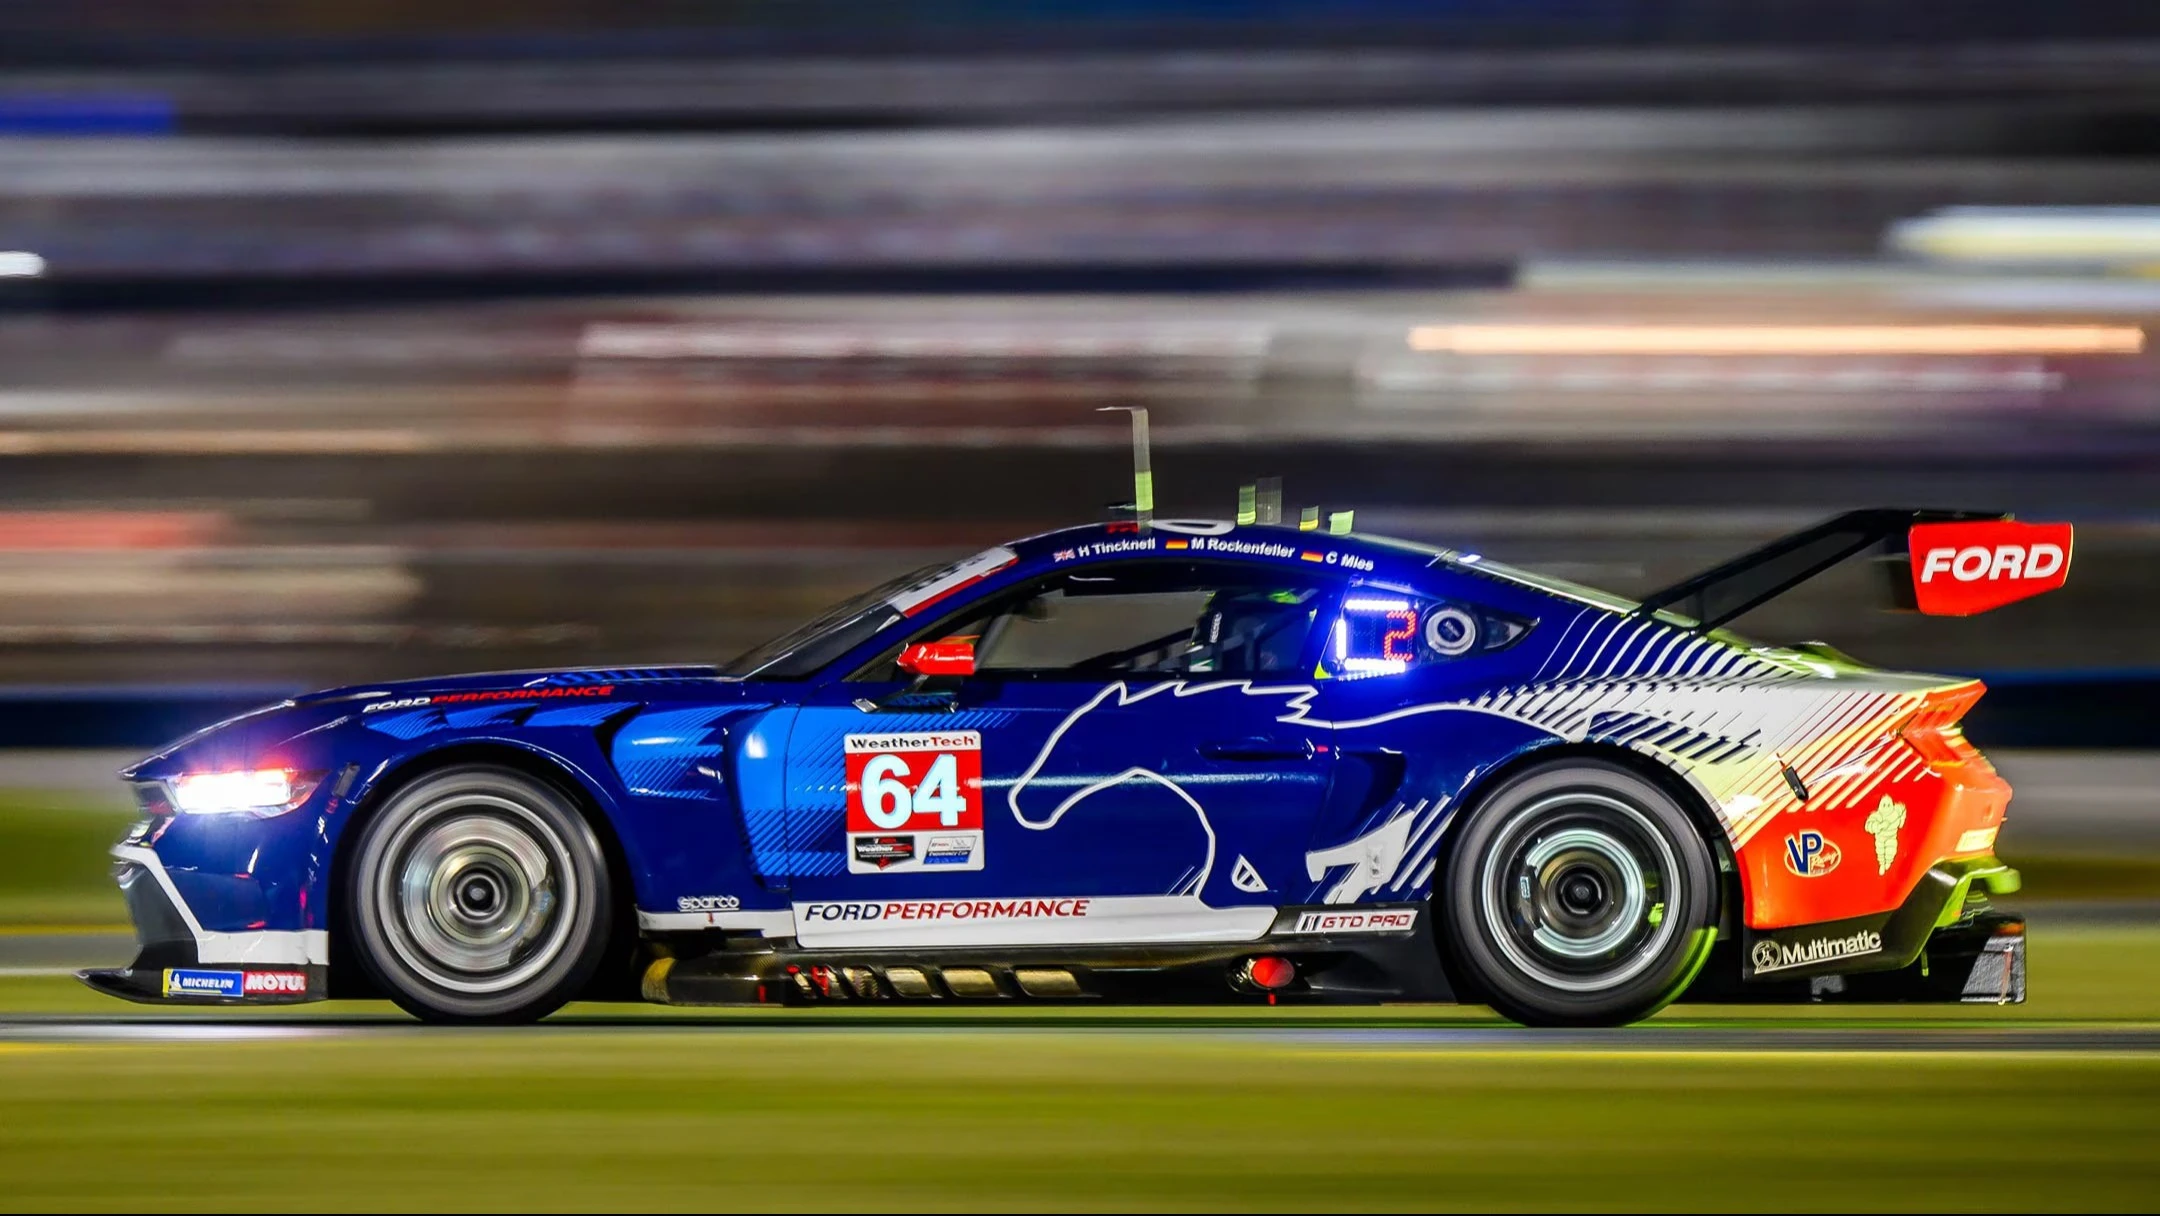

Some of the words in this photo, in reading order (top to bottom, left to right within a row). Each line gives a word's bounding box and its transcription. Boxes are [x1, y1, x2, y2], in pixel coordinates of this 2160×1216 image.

[1078, 545, 1090, 557] H
[1091, 537, 1156, 554] Tincknell
[1191, 537, 1205, 549] M
[1207, 537, 1296, 558] Rockenfeller
[1325, 550, 1338, 564] C
[1340, 553, 1374, 571] Mies
[1920, 543, 2064, 584] FORD
[851, 736, 975, 749] WeatherTech
[861, 753, 967, 830] 64
[1786, 831, 1823, 875] VP
[677, 895, 740, 911] sparco
[1321, 915, 1364, 929] GTD
[1367, 914, 1411, 928] PRO
[1782, 930, 1882, 966] Multimatic
[182, 977, 234, 989] MICHELIN
